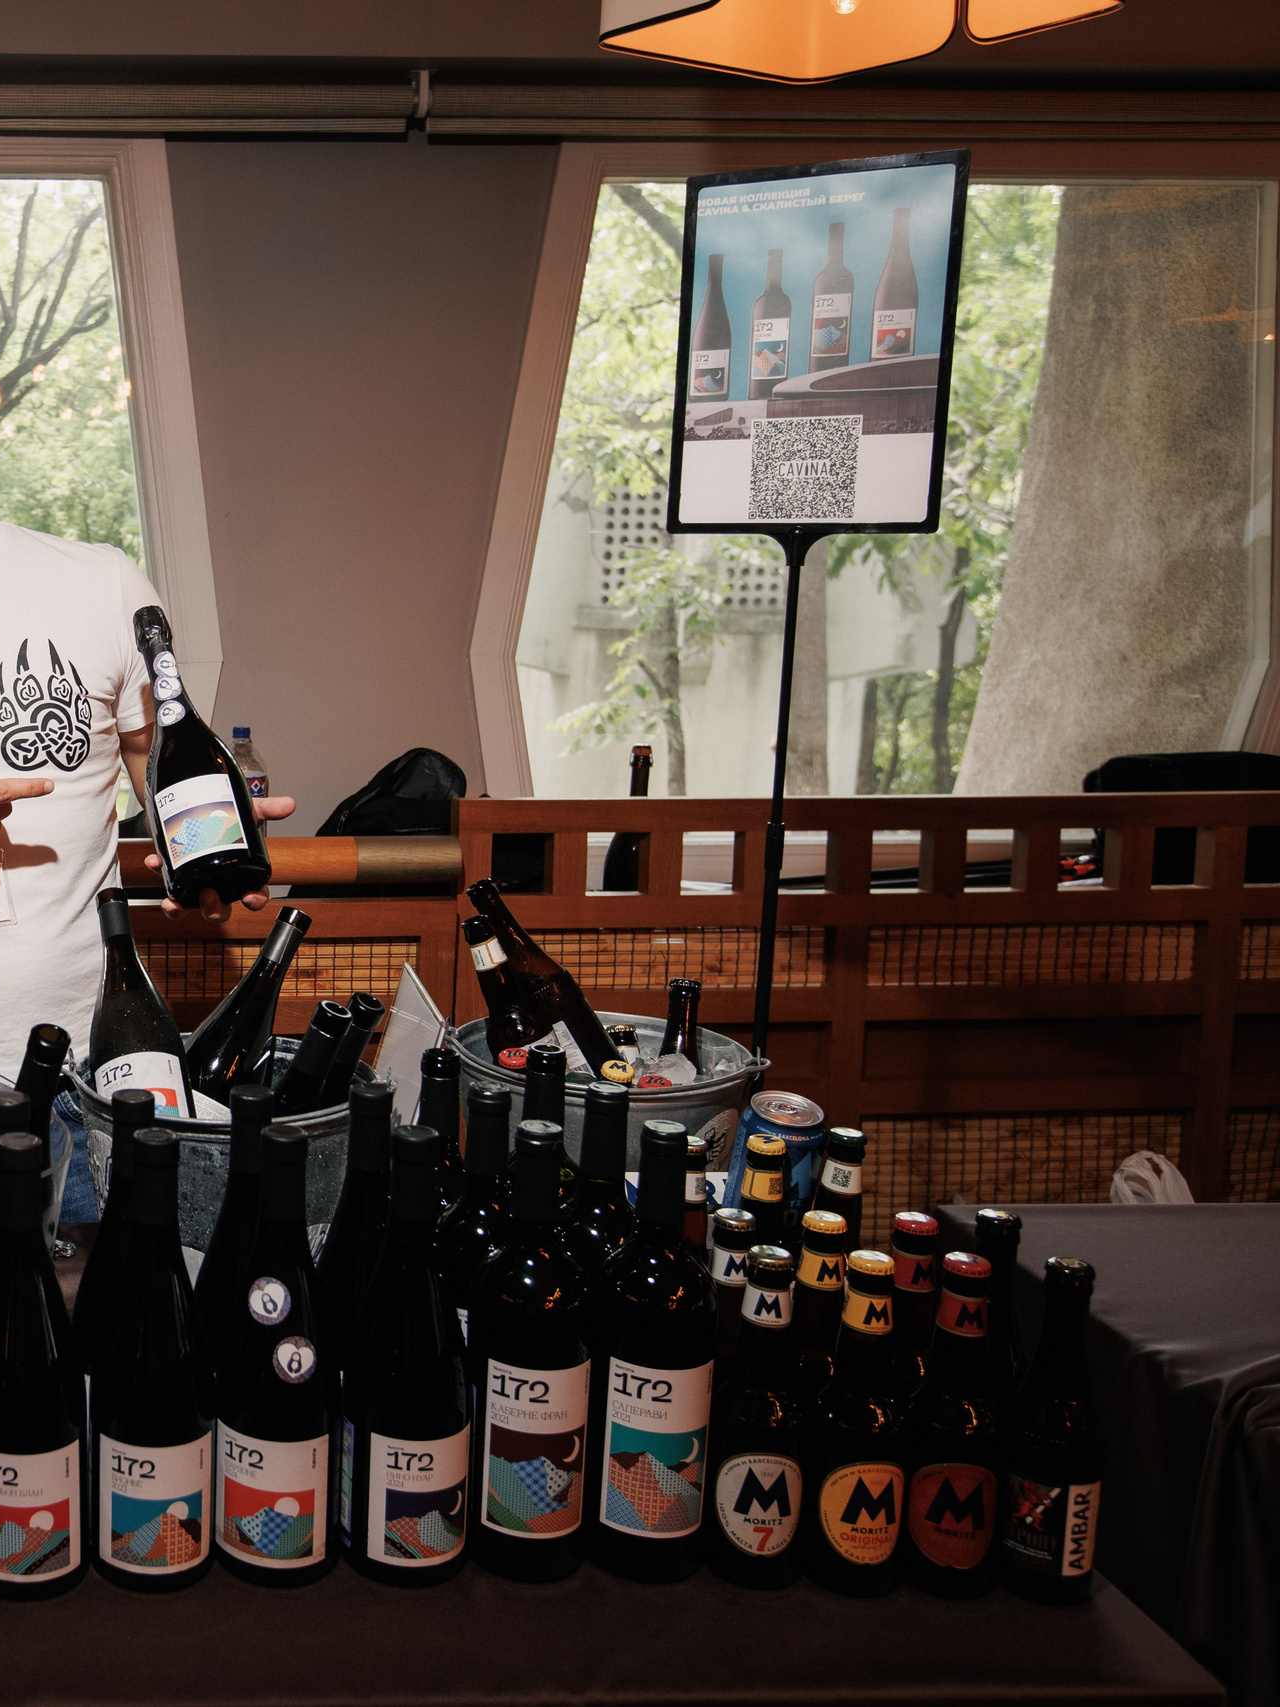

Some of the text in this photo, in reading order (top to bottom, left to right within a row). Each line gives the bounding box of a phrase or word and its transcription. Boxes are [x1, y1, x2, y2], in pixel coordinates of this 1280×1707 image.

[697, 192, 866, 217] CAVINA & СКАЛИСТЫЙ БЕРЕГ
[698, 188, 811, 208] НОВАЯ КОЛЛЕКЦИЯ
[815, 298, 834, 308] 172
[755, 322, 774, 332] 172
[877, 314, 895, 323] 172
[694, 354, 709, 362] 172
[777, 461, 828, 477] CAVINA
[157, 792, 176, 809] 172
[102, 1063, 133, 1087] 172
[777, 1132, 810, 1142] BARCELONA
[723, 1253, 748, 1278] M
[816, 1258, 841, 1282] M
[911, 1261, 934, 1284] M
[753, 1292, 782, 1318] M
[863, 1301, 890, 1325] M
[955, 1302, 983, 1328] M
[492, 1373, 549, 1404] 172
[613, 1372, 672, 1403] 172
[490, 1400, 568, 1421] КАБЕРНЕ ФРАН
[490, 1410, 509, 1424] 2021
[611, 1399, 668, 1420] САПЕРАВИ
[611, 1408, 631, 1423] 2021
[224, 1440, 264, 1470] 172
[386, 1451, 434, 1471] 172
[748, 1458, 787, 1466] BARCELONA
[111, 1454, 156, 1479] 172
[385, 1470, 434, 1482] ПИНО НУАР
[733, 1466, 791, 1518] M
[840, 1475, 896, 1526] M
[925, 1477, 985, 1531] M
[743, 1516, 783, 1526] MORITZ
[850, 1525, 889, 1535] MORITZ
[1069, 1488, 1095, 1570] AMBAR
[730, 1530, 753, 1550] MALTA
[753, 1526, 774, 1552] 7
[767, 1538, 787, 1552] LAGER
[839, 1532, 892, 1545] ORIGINAL
